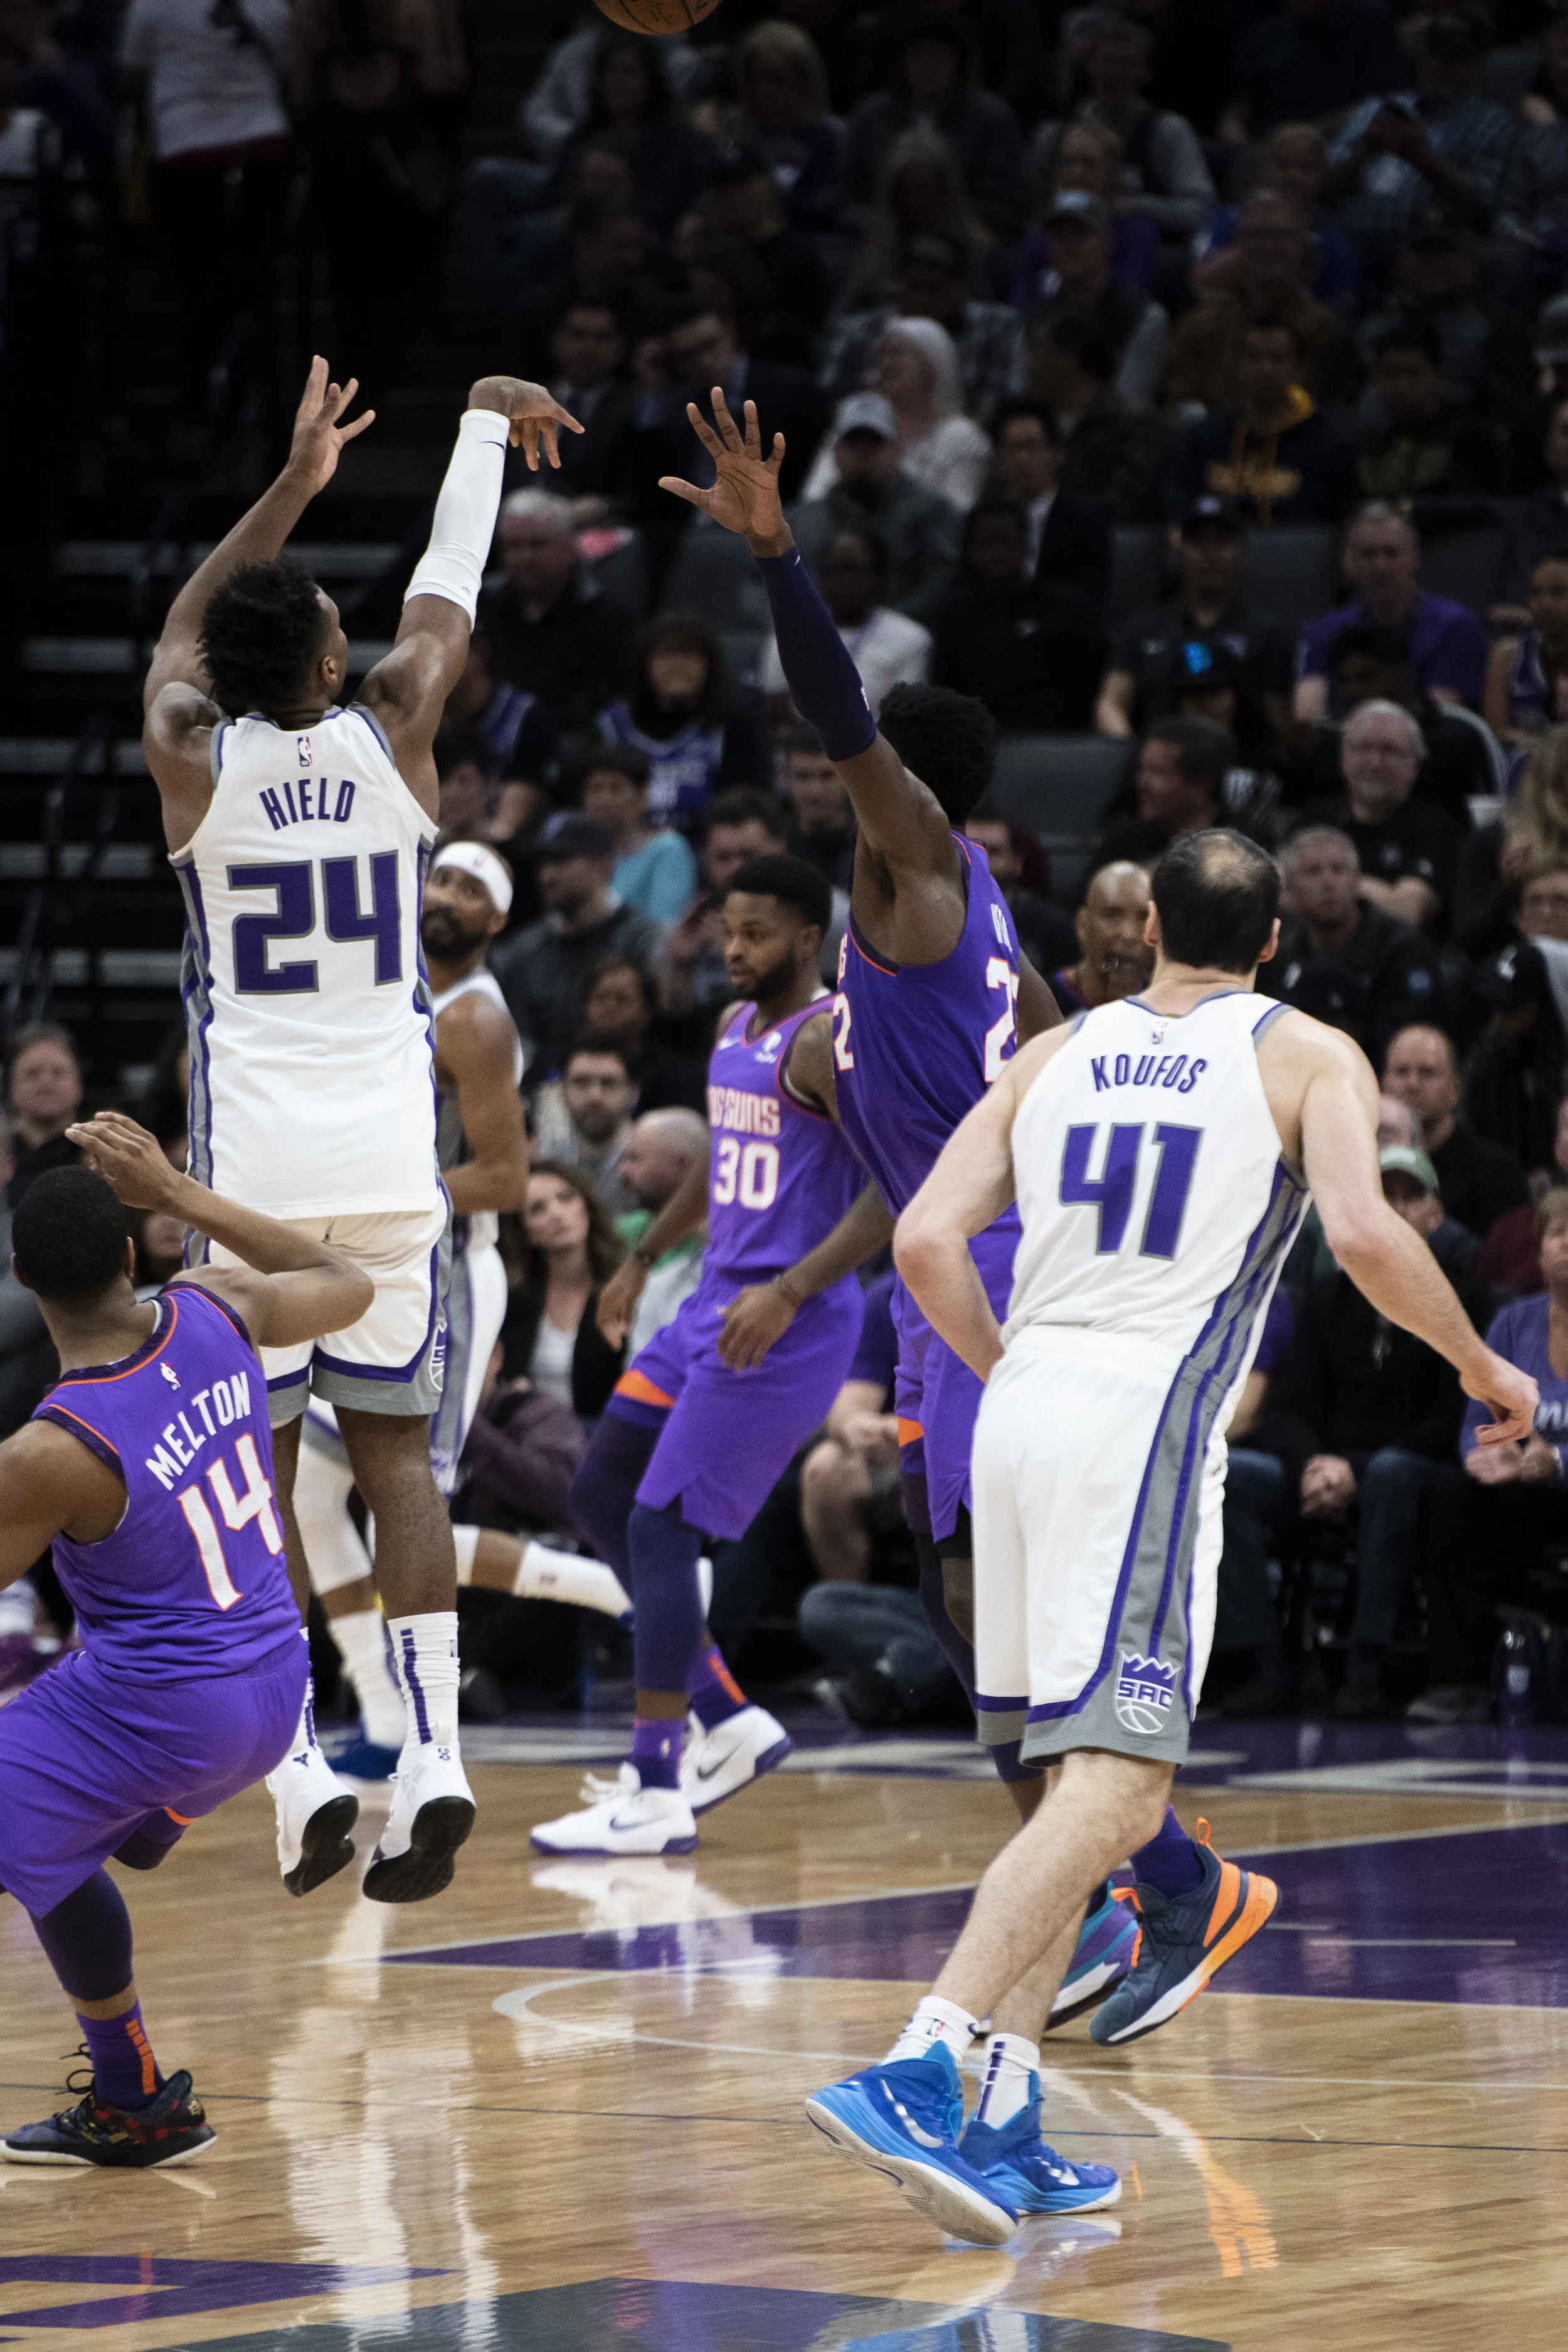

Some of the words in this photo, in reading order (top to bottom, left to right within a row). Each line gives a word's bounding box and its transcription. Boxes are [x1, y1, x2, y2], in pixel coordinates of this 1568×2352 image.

[259, 778, 356, 830] HIELD
[226, 849, 403, 995] 24
[1091, 1054, 1209, 1094] KOUFOS
[713, 1136, 780, 1210] 30
[1058, 1121, 1205, 1261] 41
[145, 1371, 251, 1491] MELTON
[177, 1433, 283, 1611] 14
[1118, 1680, 1173, 1709] SAC
